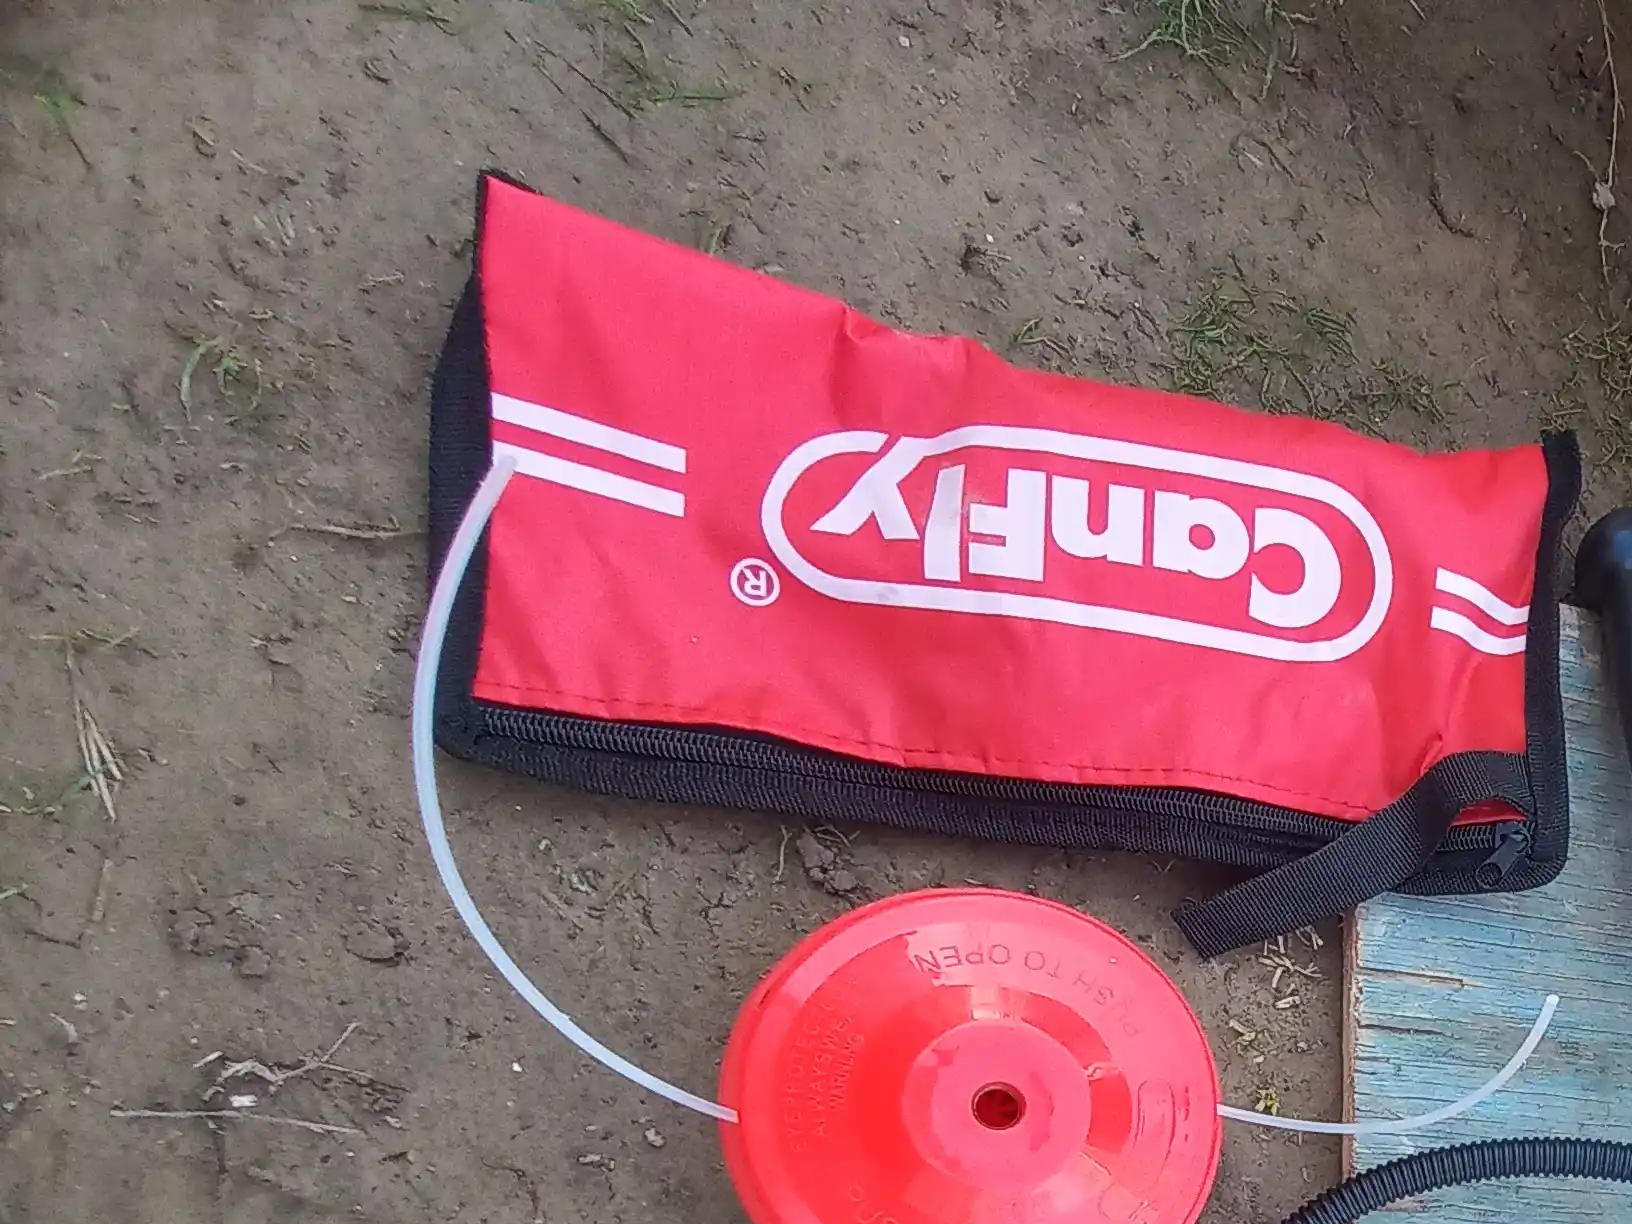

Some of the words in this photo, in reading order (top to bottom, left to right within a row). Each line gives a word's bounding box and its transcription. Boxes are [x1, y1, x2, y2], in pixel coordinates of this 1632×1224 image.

[809, 435, 1342, 628] CanFly
[914, 944, 1011, 974] OPEN
[1024, 950, 1061, 980] TO
